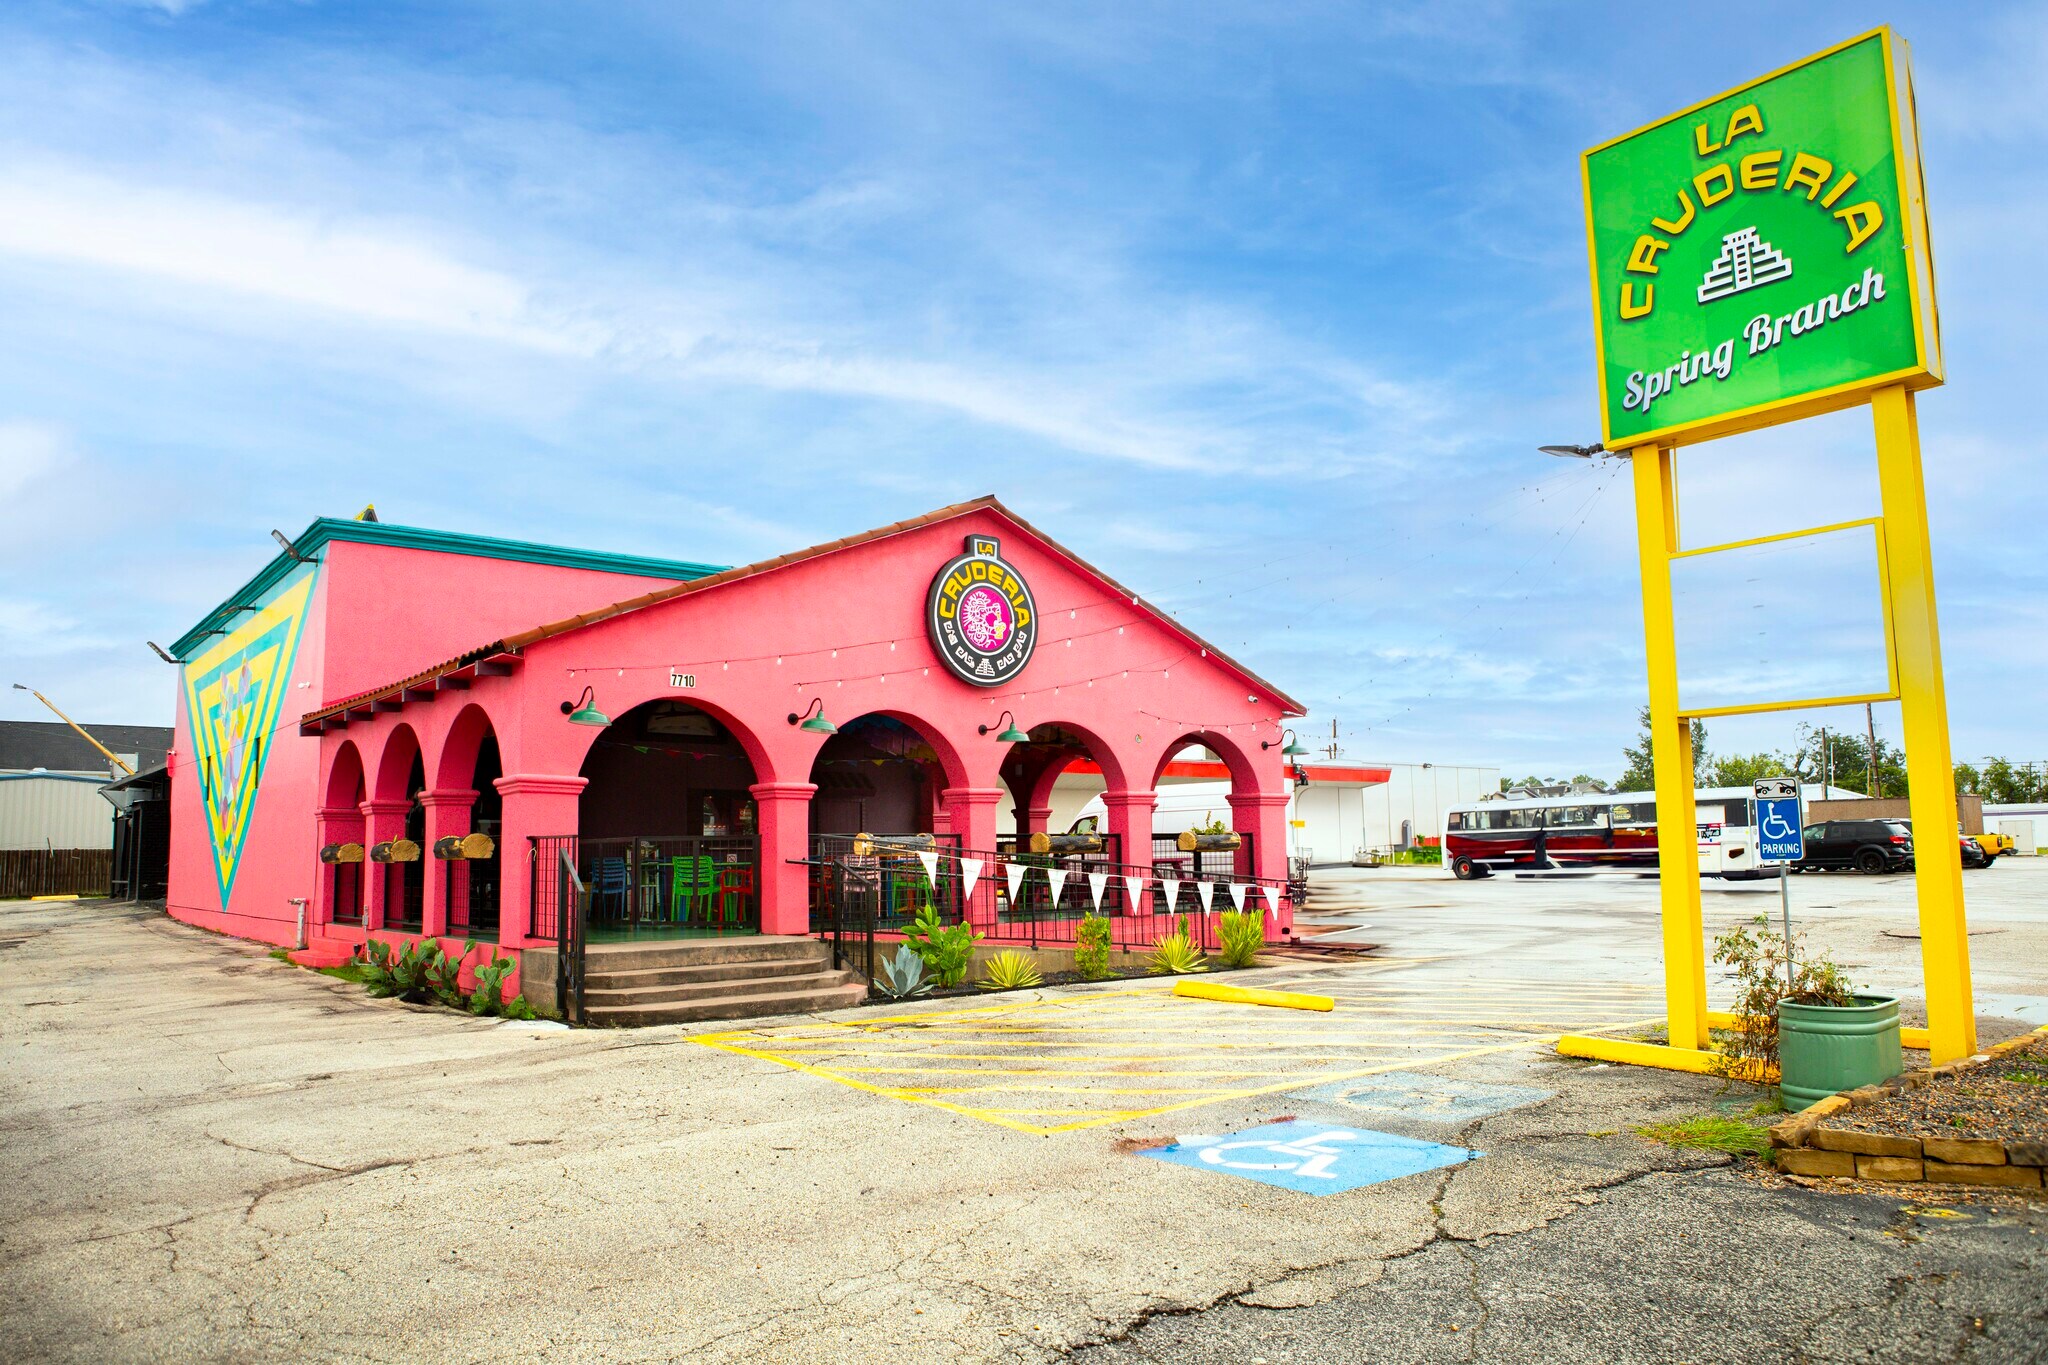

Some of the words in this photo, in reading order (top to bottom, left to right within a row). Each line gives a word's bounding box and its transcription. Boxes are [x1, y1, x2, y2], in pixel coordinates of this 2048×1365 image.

[1695, 104, 1764, 156] LA
[1620, 150, 1884, 320] CRUDERIA
[1622, 338, 1735, 413] Spring
[1743, 267, 1885, 355] Branch
[978, 543, 994, 555] LA
[940, 561, 1030, 629] CRUDERIA
[671, 674, 695, 688] 7710
[1762, 843, 1800, 854] PARKING
